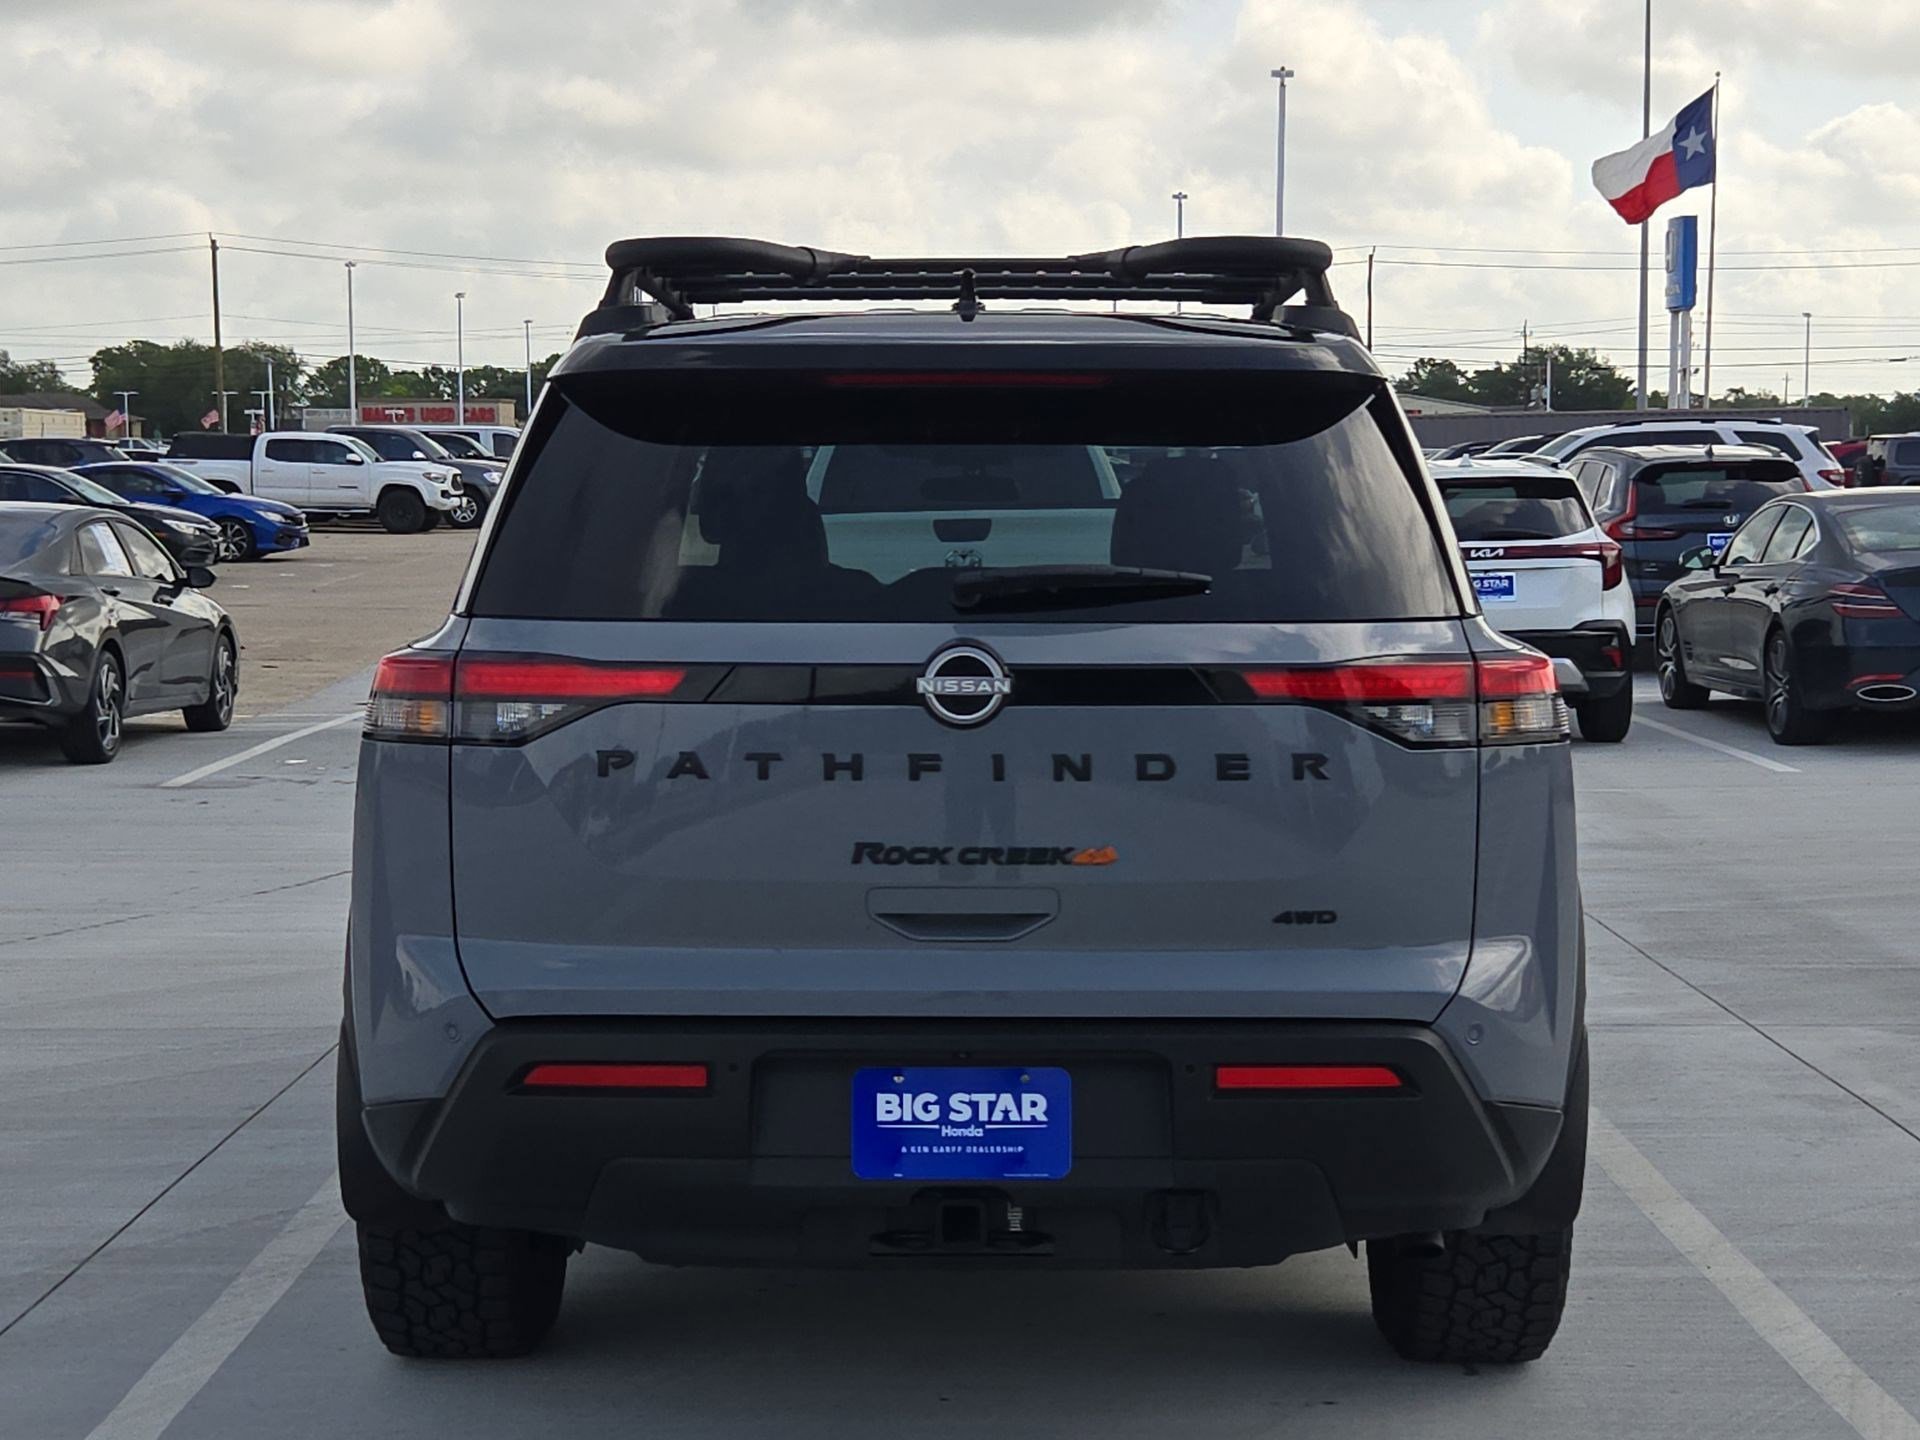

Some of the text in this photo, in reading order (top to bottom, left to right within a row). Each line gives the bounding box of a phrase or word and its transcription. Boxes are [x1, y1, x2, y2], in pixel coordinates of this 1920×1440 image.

[420, 407, 455, 422] USED
[1470, 548, 1504, 558] KIA
[1483, 579, 1509, 588] STAR
[918, 680, 1010, 693] NISSAN
[596, 749, 1331, 782] PATHFINDER
[851, 842, 1075, 865] ROCK CREEK
[1271, 910, 1338, 925] 4WD
[876, 1092, 1049, 1122] BIG STAR
[941, 1124, 984, 1137] Honda
